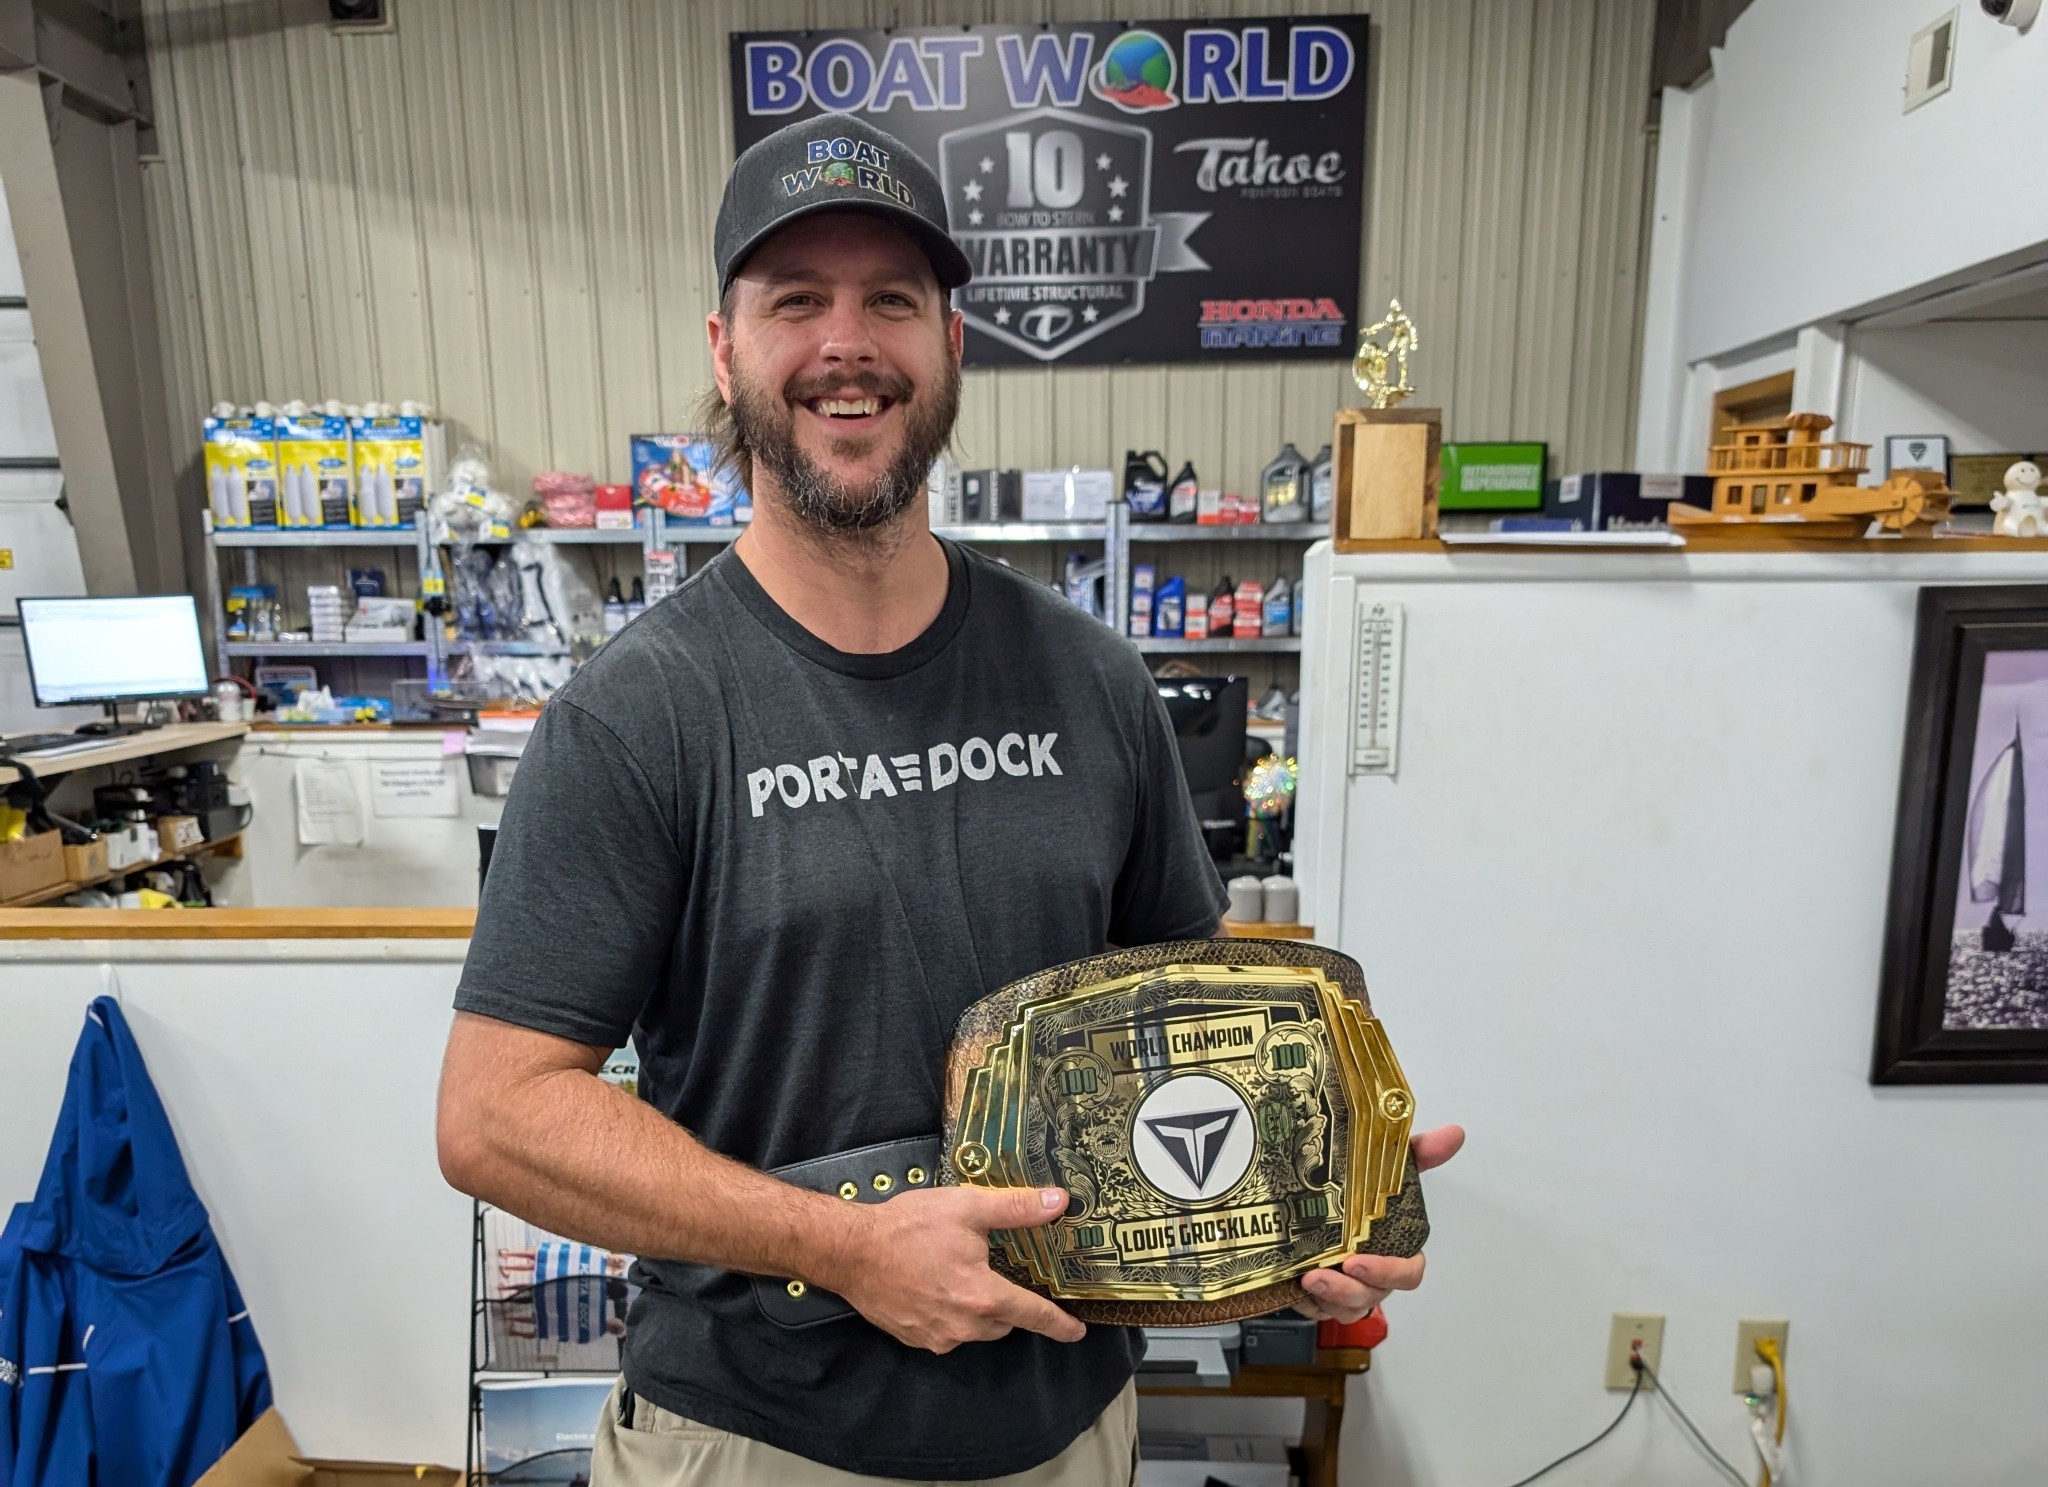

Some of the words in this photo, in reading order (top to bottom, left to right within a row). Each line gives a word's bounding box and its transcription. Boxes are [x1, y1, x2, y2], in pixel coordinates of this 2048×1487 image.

[745, 34, 984, 115] BOAT
[807, 137, 890, 171] BOAT
[1005, 130, 1085, 209] 10
[1173, 136, 1347, 192] Tahoe
[959, 234, 1138, 278] WARRANTY
[1200, 298, 1344, 321] HONDA
[1110, 1036, 1168, 1061] WORLD
[1172, 1025, 1254, 1054] CHAMPION
[1268, 1041, 1308, 1072] 100
[1057, 1066, 1098, 1096] 100
[1299, 1196, 1329, 1220] 100
[1072, 1224, 1105, 1249] 100
[1122, 1229, 1175, 1253] LOUIS
[1180, 1211, 1284, 1246] GROSKLAGS
